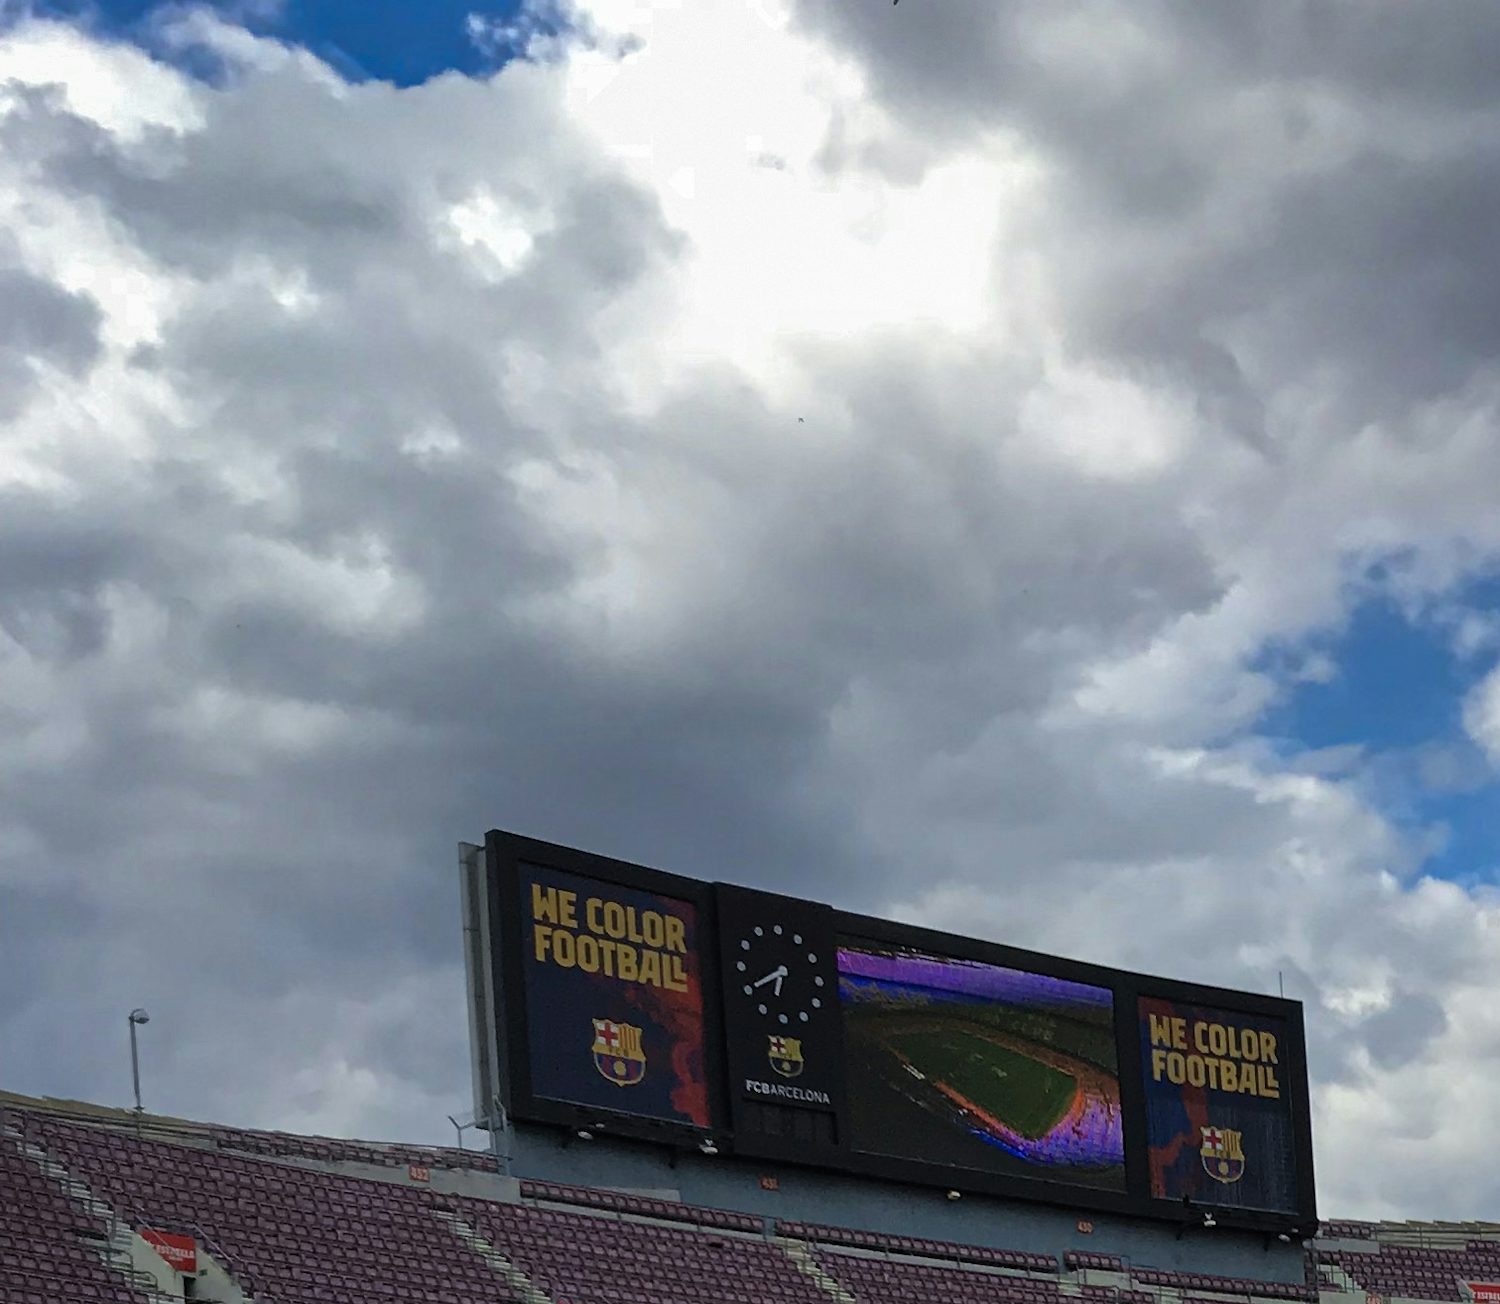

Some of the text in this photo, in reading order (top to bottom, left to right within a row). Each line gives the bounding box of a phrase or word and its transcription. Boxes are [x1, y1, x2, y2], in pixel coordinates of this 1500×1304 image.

[531, 883, 687, 953] WE COLOR
[534, 924, 688, 992] FOOTBALL
[1149, 1013, 1279, 1064] WE COLOR
[745, 1079, 831, 1105] FCBARCELONA
[1152, 1049, 1280, 1098] FOOTBALL
